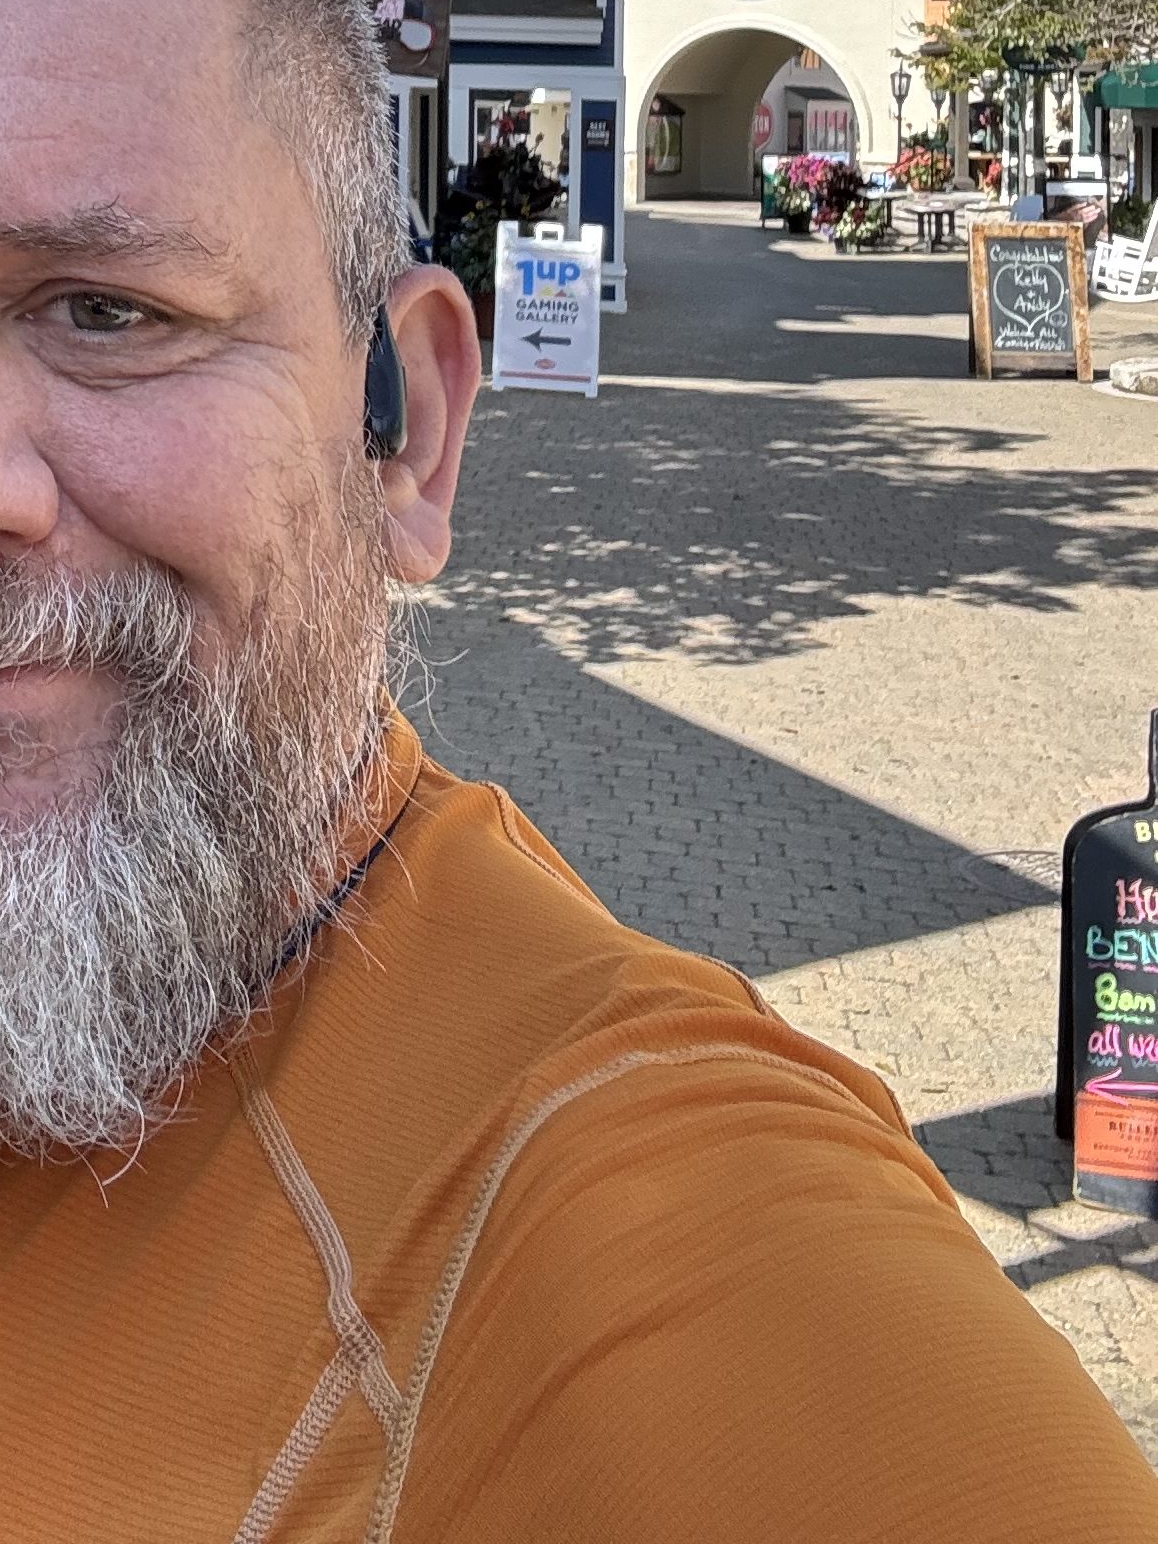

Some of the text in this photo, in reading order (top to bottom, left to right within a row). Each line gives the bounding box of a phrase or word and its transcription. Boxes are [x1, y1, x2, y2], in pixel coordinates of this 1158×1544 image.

[1014, 267, 1049, 294] Kelly
[515, 311, 579, 324] GALLERY
[516, 298, 580, 313] GAMING
[1013, 294, 1051, 323] Andy
[1095, 972, 1156, 1012] 8am
[1088, 1024, 1122, 1057] all
